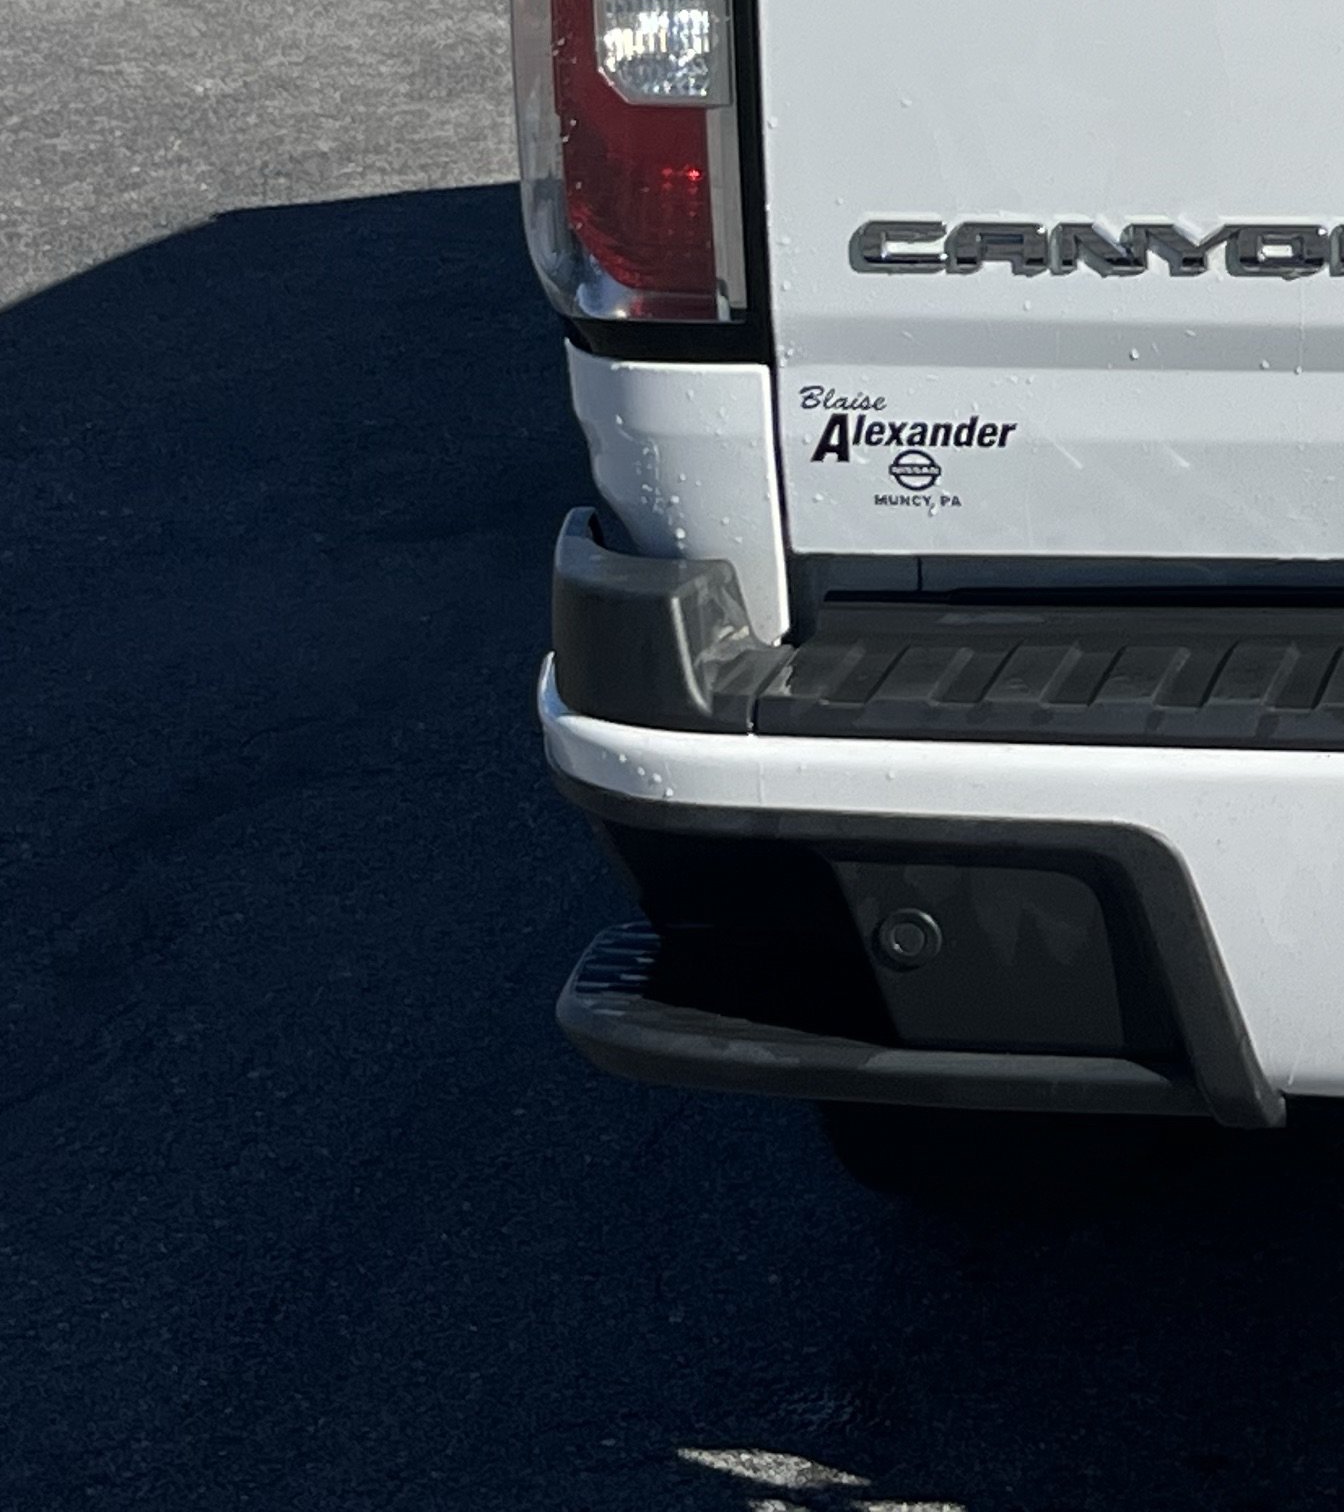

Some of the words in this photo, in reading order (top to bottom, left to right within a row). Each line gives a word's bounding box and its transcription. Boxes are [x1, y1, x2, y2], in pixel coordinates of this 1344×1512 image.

[799, 385, 888, 412] Blaise
[810, 413, 1018, 463] Alexander
[874, 494, 935, 509] MUNCY,
[940, 494, 961, 506] PA
